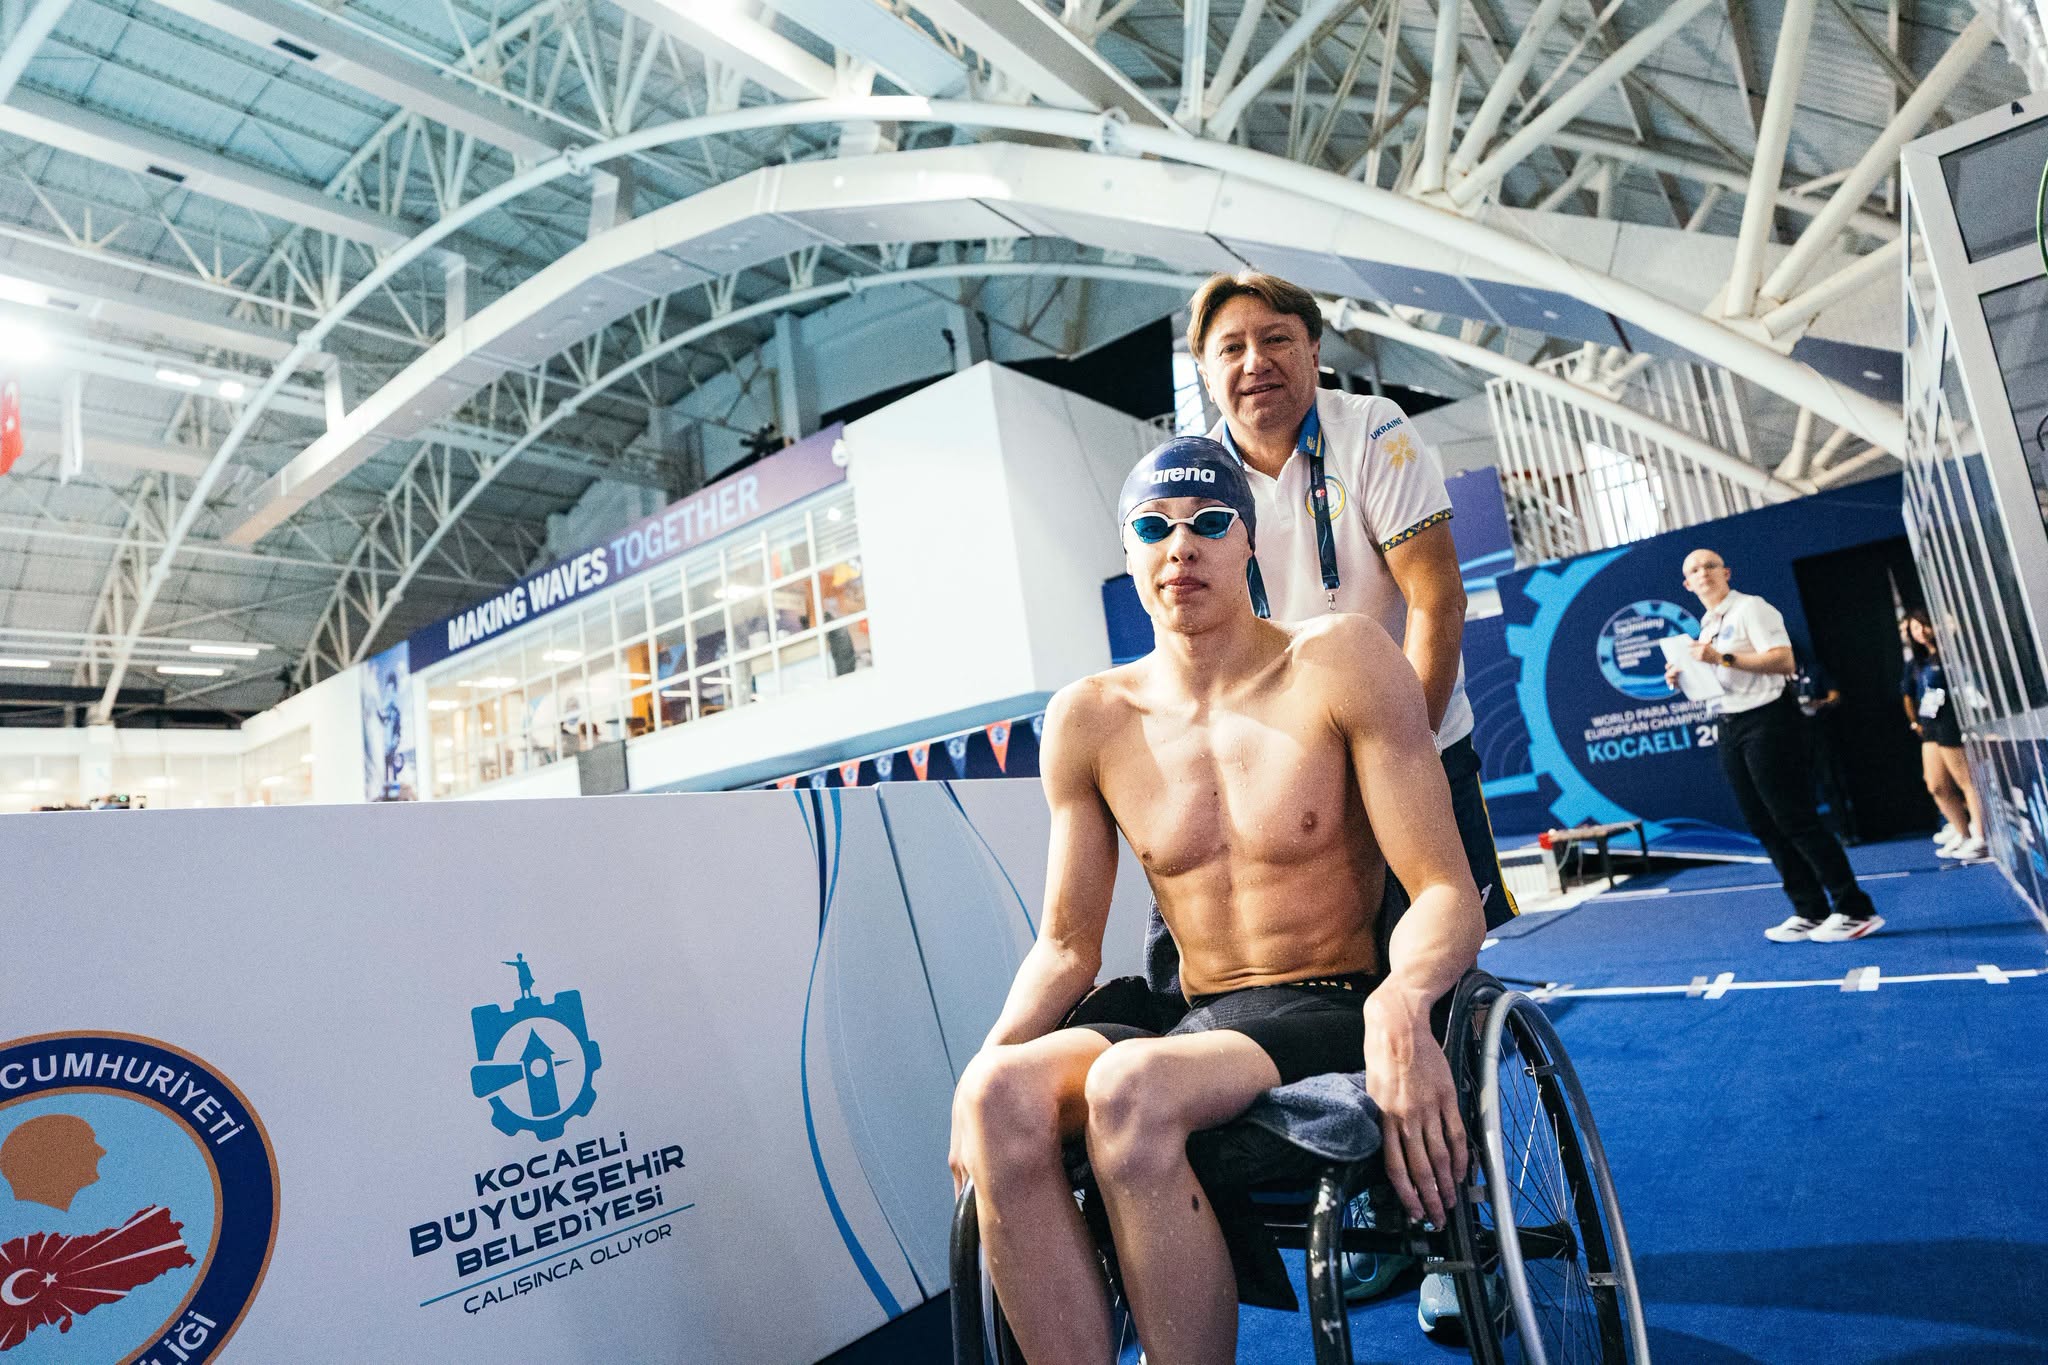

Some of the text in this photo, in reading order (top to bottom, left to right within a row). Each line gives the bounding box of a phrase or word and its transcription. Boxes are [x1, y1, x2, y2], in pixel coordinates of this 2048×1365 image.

[1370, 417, 1404, 440] UKRAINE
[1150, 467, 1216, 484] arena
[448, 474, 761, 651] MAKING WAVES TOGETHER
[1584, 723, 1650, 742] EUROPEAN
[1591, 711, 1635, 728] WORLD
[1635, 705, 1669, 721] PARA
[474, 1131, 628, 1197] KOCAELİ
[409, 1144, 686, 1257] BÜYÜKŞEHİR
[455, 1184, 664, 1278] BELEDİYESİ
[463, 1223, 672, 1315] ÇALIŞINCA OLUYOR
